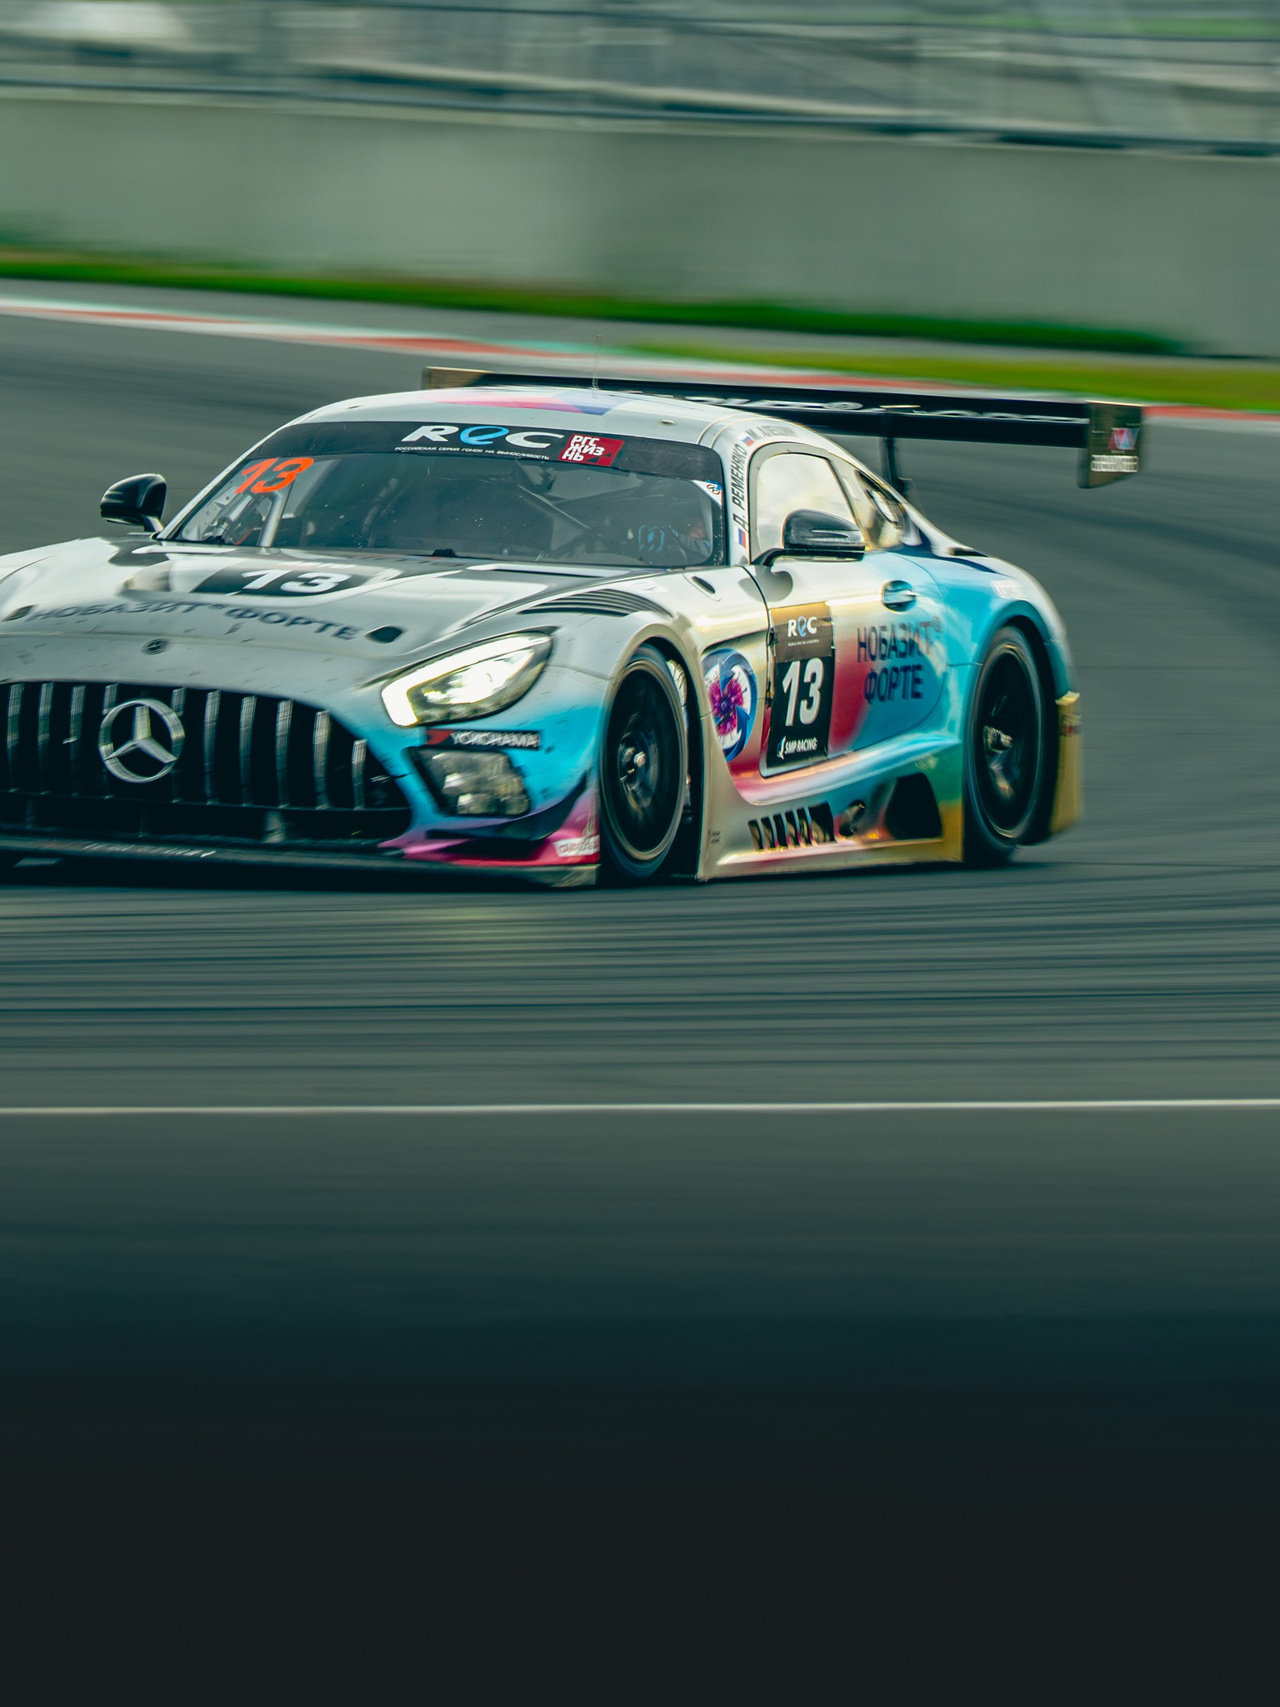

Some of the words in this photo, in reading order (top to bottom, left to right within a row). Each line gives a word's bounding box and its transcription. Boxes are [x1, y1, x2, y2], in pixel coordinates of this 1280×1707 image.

[570, 435, 600, 447] РГС
[234, 457, 315, 494] 13
[240, 569, 353, 593] 13
[782, 657, 825, 727] 13
[864, 664, 924, 704] ФОРТЕ
[451, 730, 539, 748] YOKOHAMA
